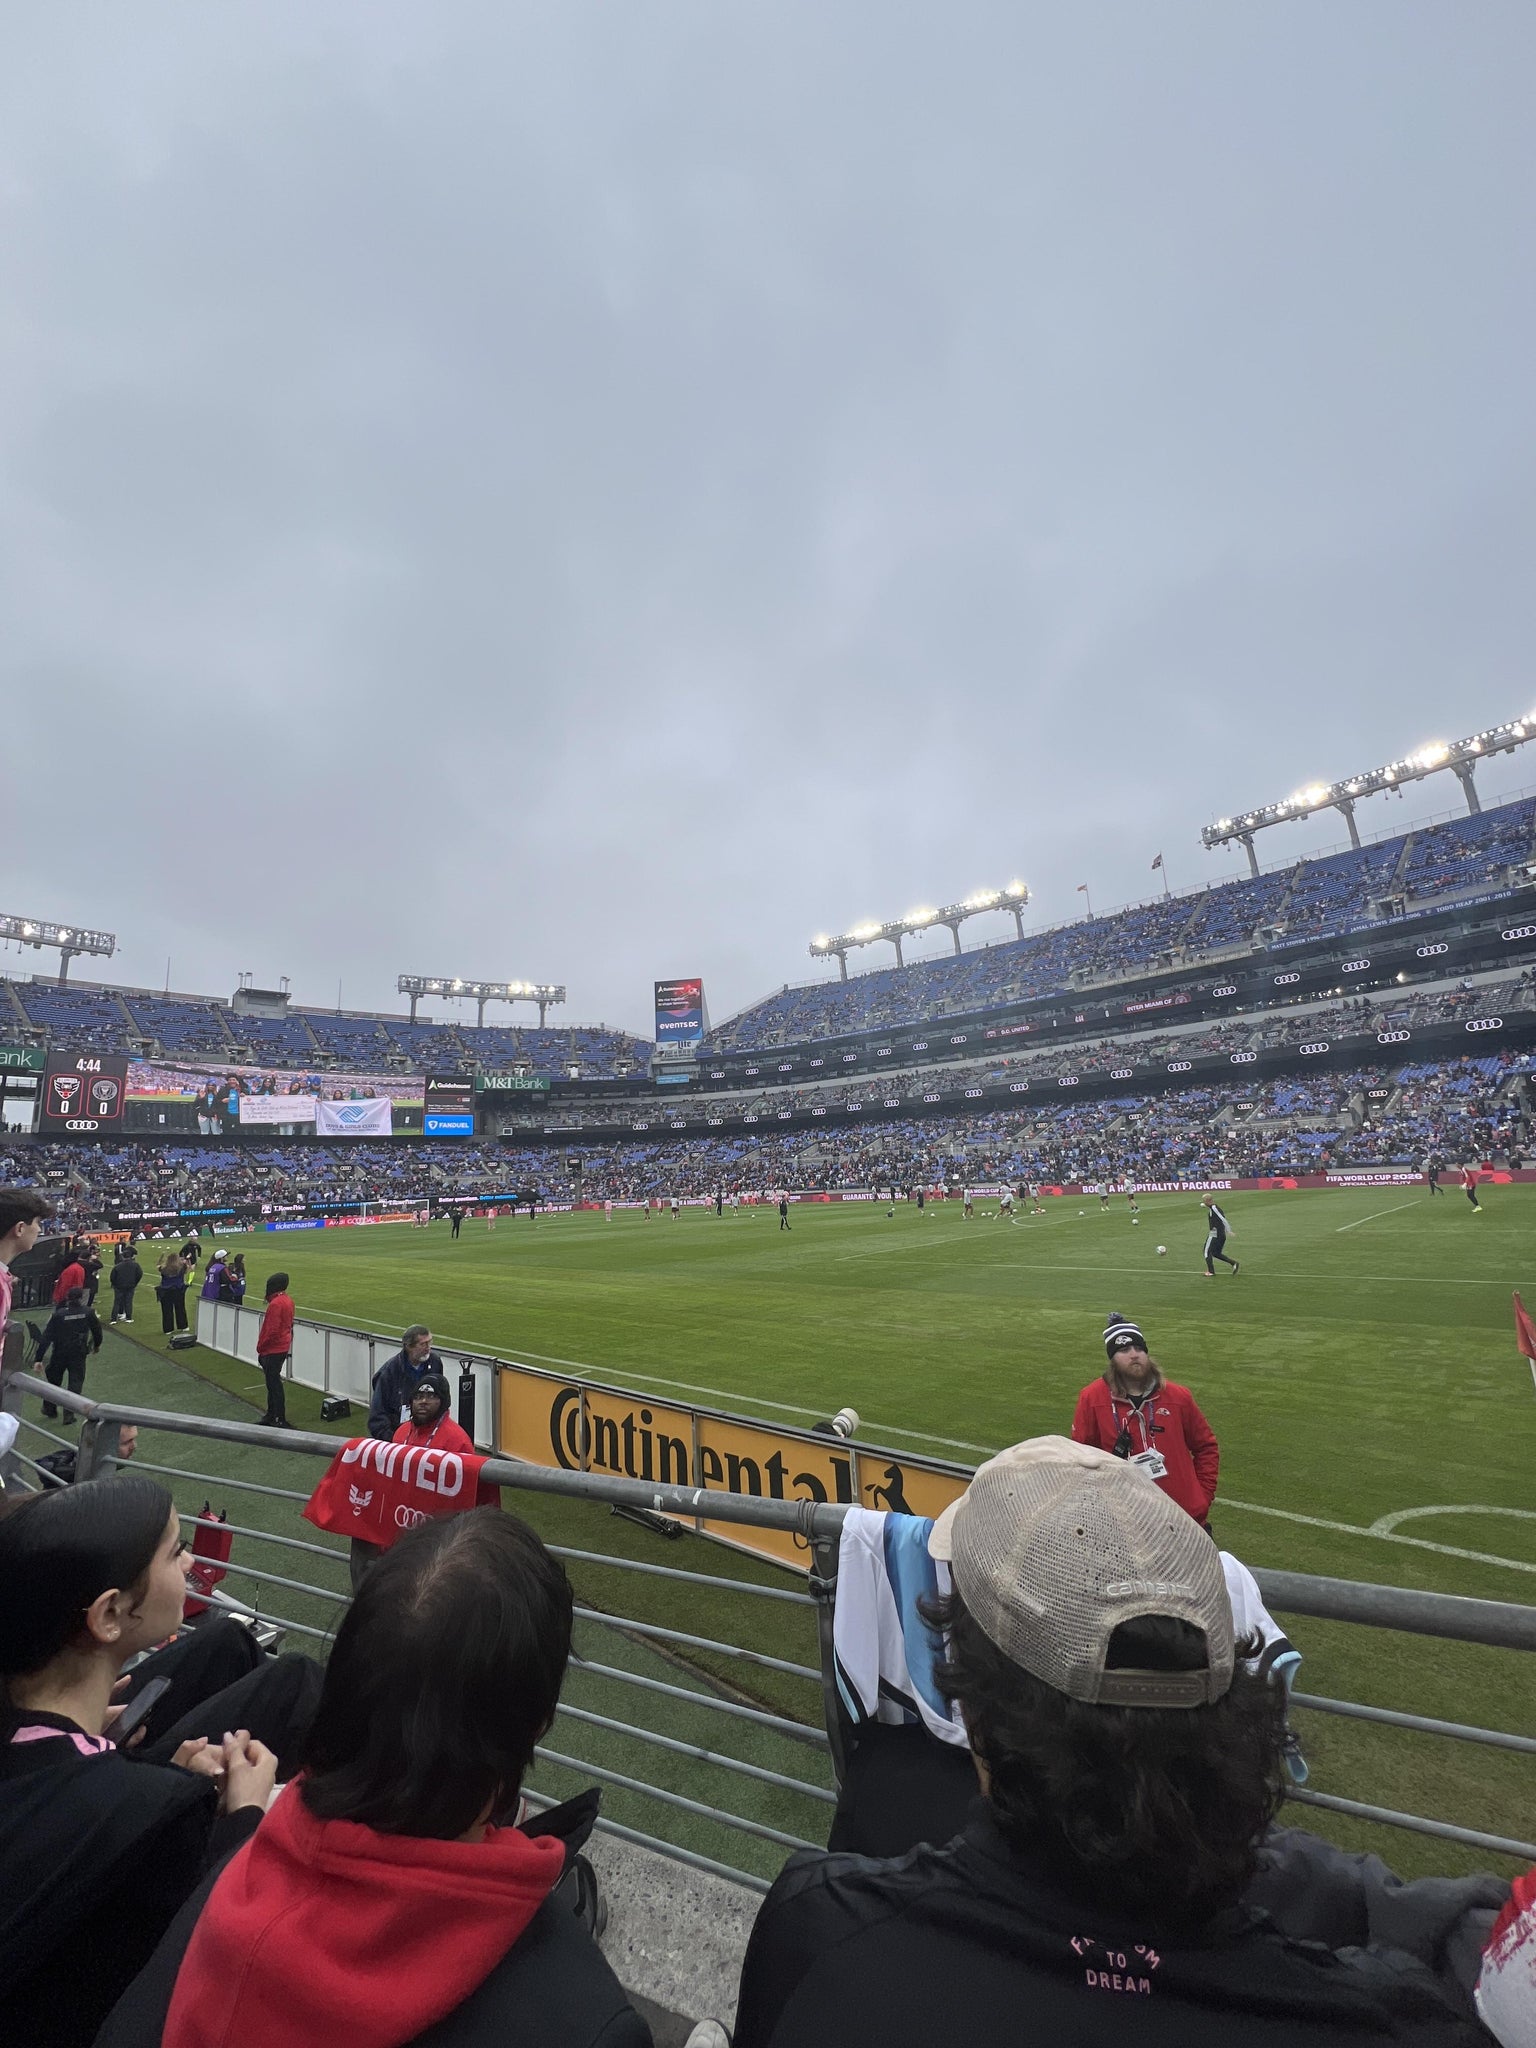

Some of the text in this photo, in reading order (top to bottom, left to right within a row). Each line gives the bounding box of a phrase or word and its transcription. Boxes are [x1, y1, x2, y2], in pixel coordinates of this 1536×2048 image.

[1126, 1004, 1144, 1012] INTER
[1144, 1000, 1163, 1009] MIAMI
[688, 1020, 699, 1028] DC
[1011, 1025, 1030, 1034] UNITED
[76, 1058, 102, 1072] 4:44
[483, 1076, 545, 1089] M&T Bank
[60, 1100, 70, 1114] 0
[99, 1102, 108, 1115] 0
[439, 1121, 470, 1129] FANDUEL
[1343, 1174, 1374, 1182] WORLD
[1108, 1184, 1116, 1193] A
[1117, 1181, 1179, 1193] HSPITALITY
[1182, 1180, 1232, 1191] PACKAGE
[118, 1212, 141, 1220] Better
[142, 1211, 179, 1220] questions.
[275, 1221, 318, 1230] ticketmaster
[550, 1387, 852, 1505] Continental
[341, 1438, 464, 1497] UNITED
[1106, 1951, 1127, 1969] TO
[1086, 1969, 1151, 1995] DREAM
